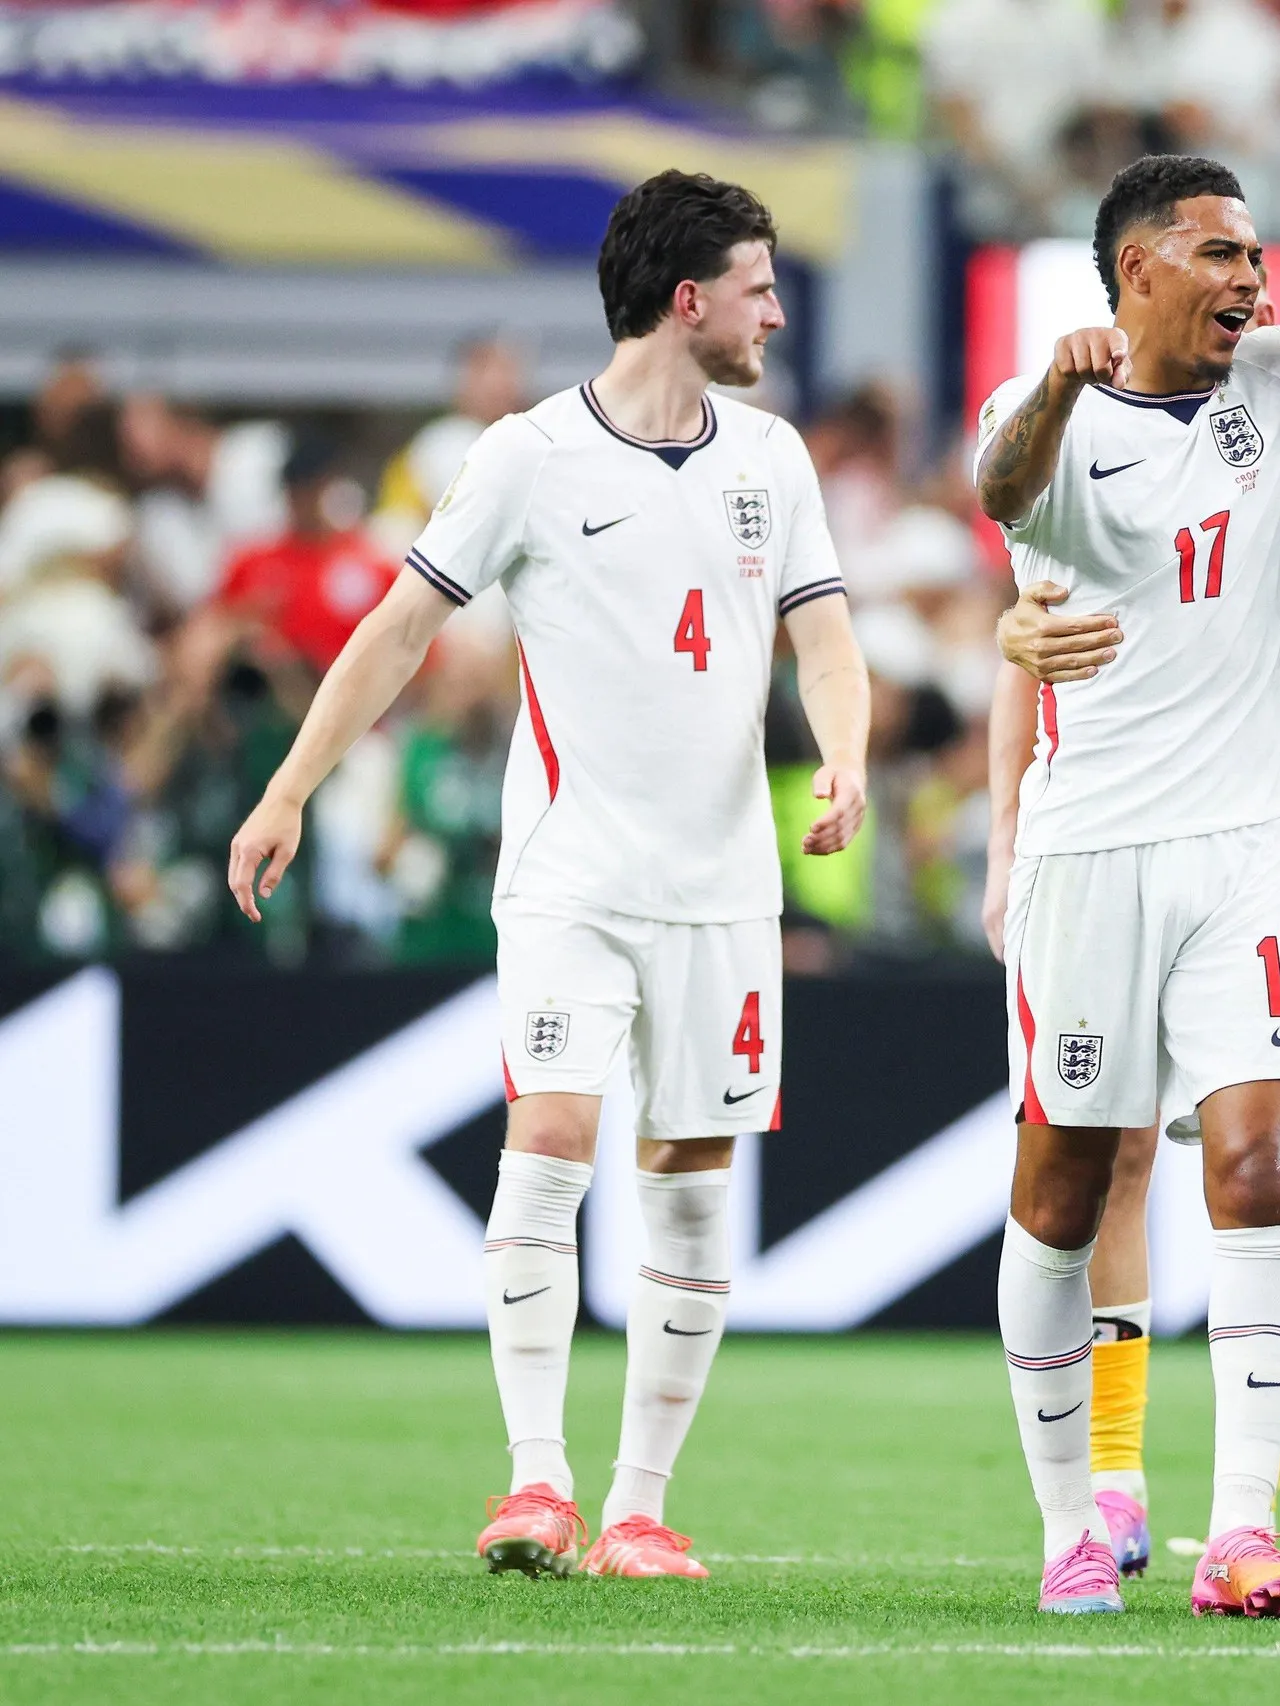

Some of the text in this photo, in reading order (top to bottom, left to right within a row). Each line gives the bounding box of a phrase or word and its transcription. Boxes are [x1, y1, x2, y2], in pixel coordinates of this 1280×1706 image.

[1175, 510, 1230, 604] 17
[674, 588, 711, 673] 4
[732, 990, 764, 1074] 4
